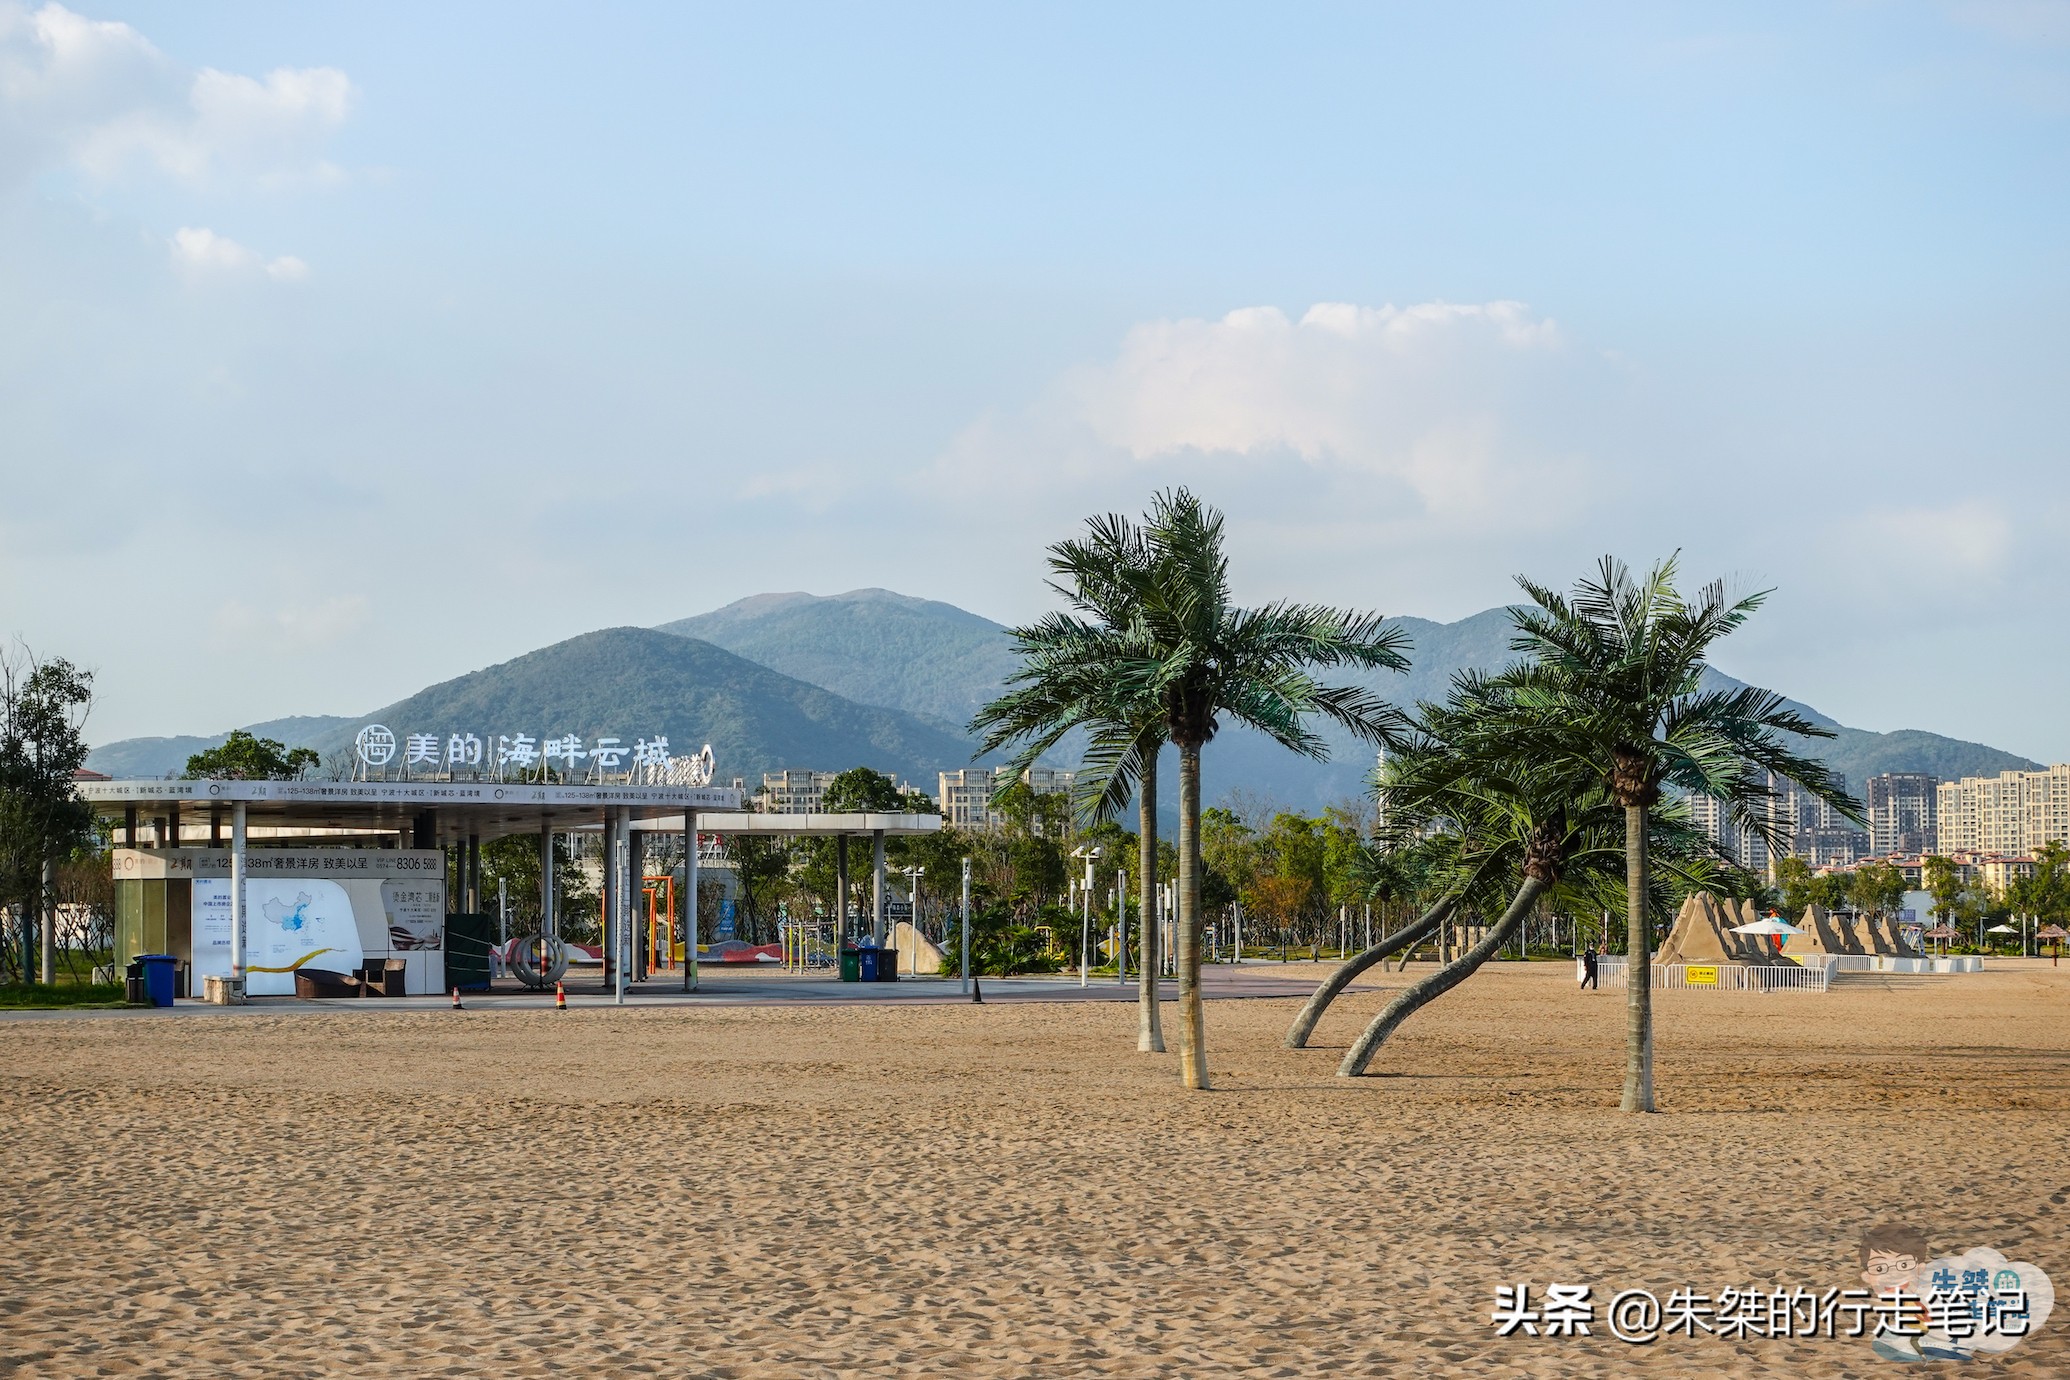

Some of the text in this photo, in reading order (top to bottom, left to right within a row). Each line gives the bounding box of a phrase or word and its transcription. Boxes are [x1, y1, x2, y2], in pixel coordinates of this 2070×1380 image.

[407, 733, 482, 765] 美的
[499, 732, 674, 770] 海畔云城
[323, 857, 368, 870] 致美以呈
[396, 857, 421, 870] 8306
